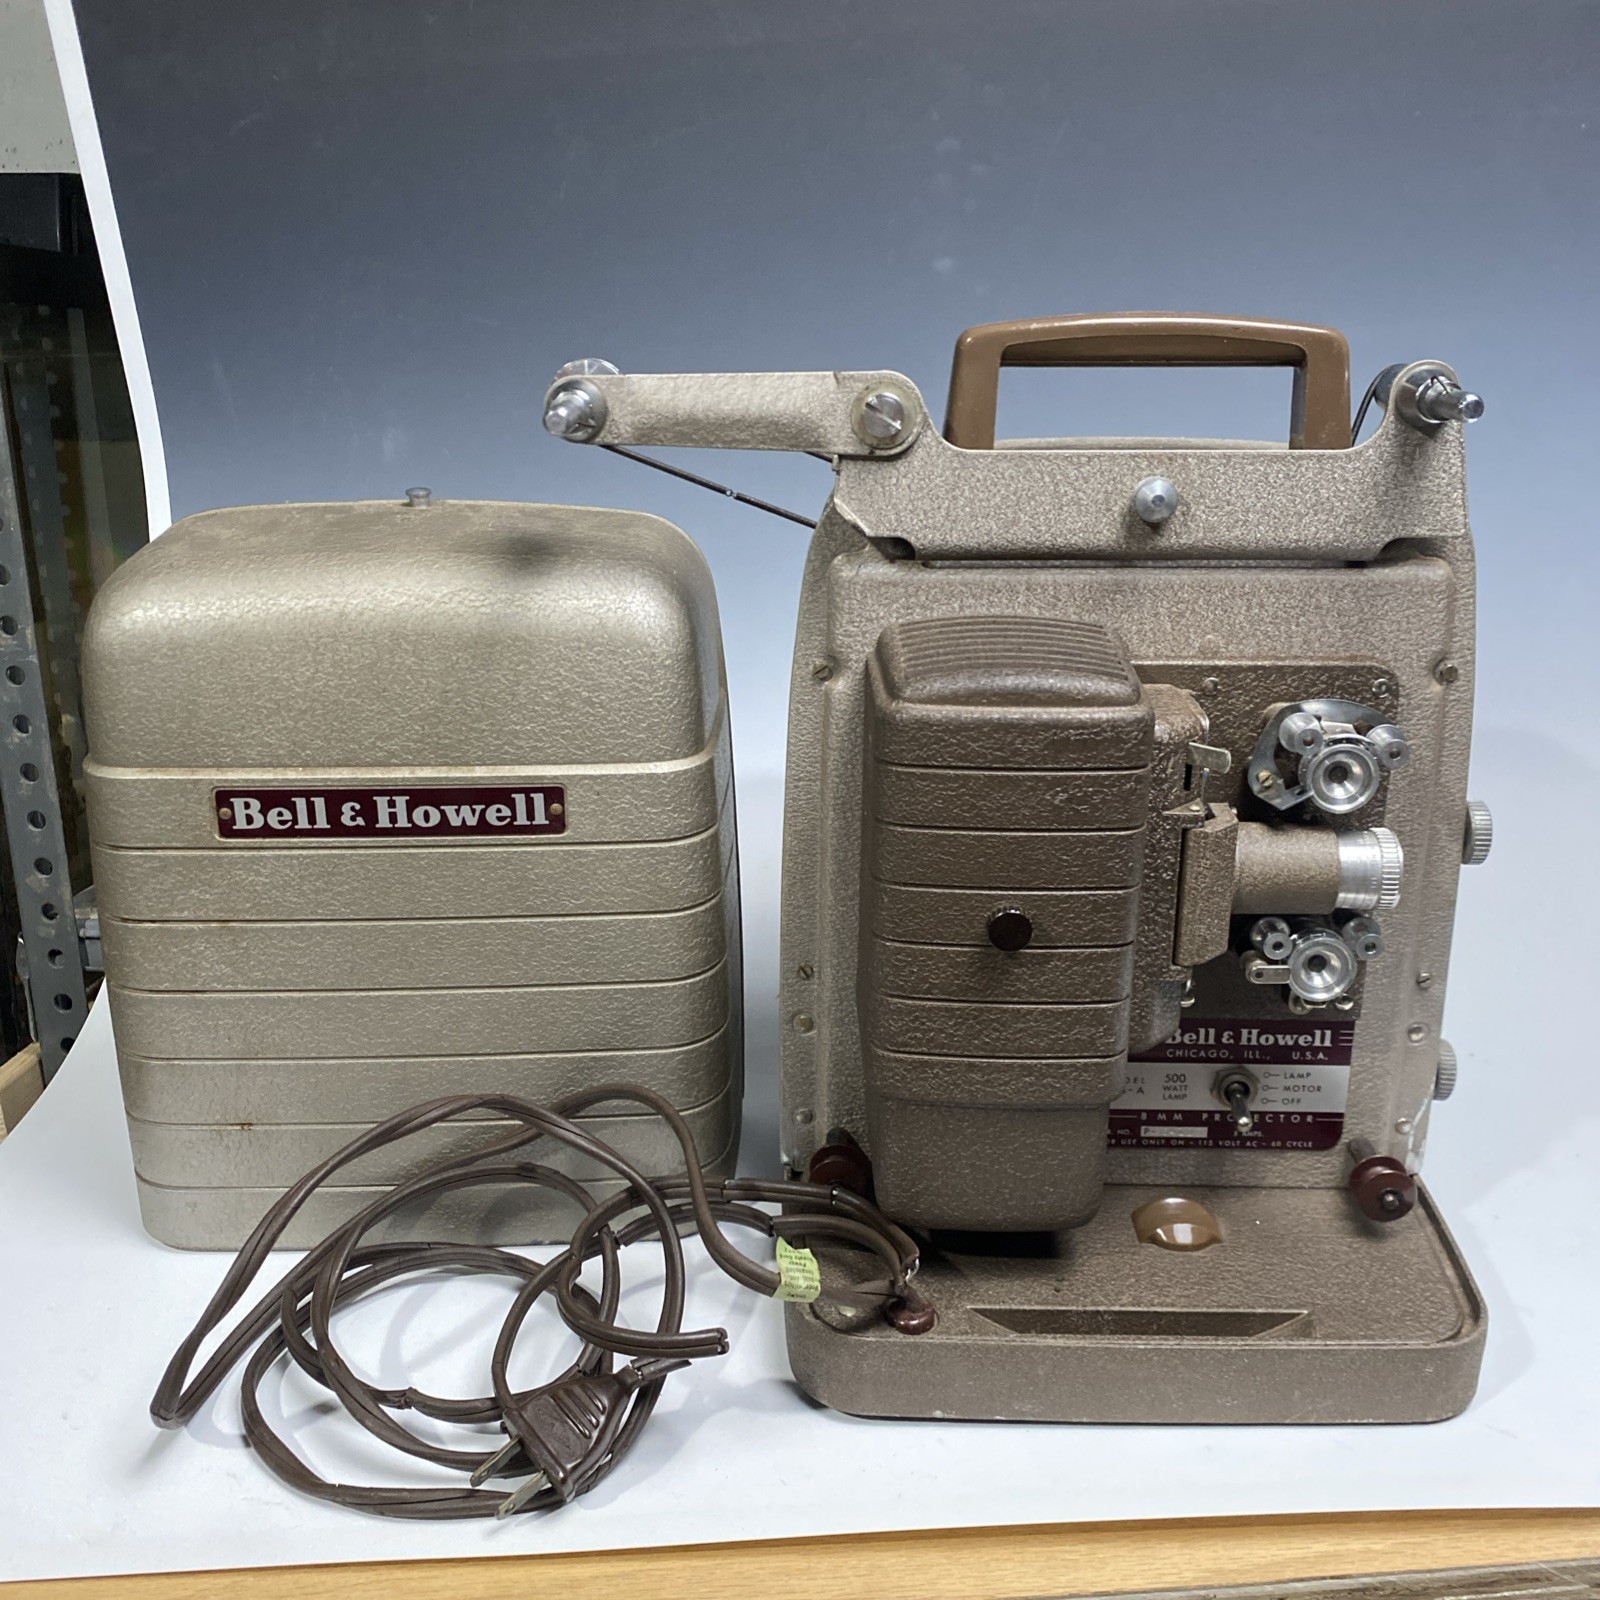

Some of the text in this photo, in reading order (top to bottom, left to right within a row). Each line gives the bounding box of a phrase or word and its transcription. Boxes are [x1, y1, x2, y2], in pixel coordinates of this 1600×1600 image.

[230, 793, 550, 830] Bell & Howell
[1164, 1028, 1333, 1047] Bell & Howell
[1292, 1051, 1328, 1061] U.S.A.
[1164, 1073, 1187, 1084] 500
[1283, 1072, 1312, 1080] LAMP
[1162, 1084, 1189, 1092] WATT
[1282, 1085, 1322, 1093] MOTOR
[1162, 1093, 1188, 1101] LAMP
[1281, 1097, 1302, 1106] OFF
[1201, 1113, 1314, 1123] PROECTOR
